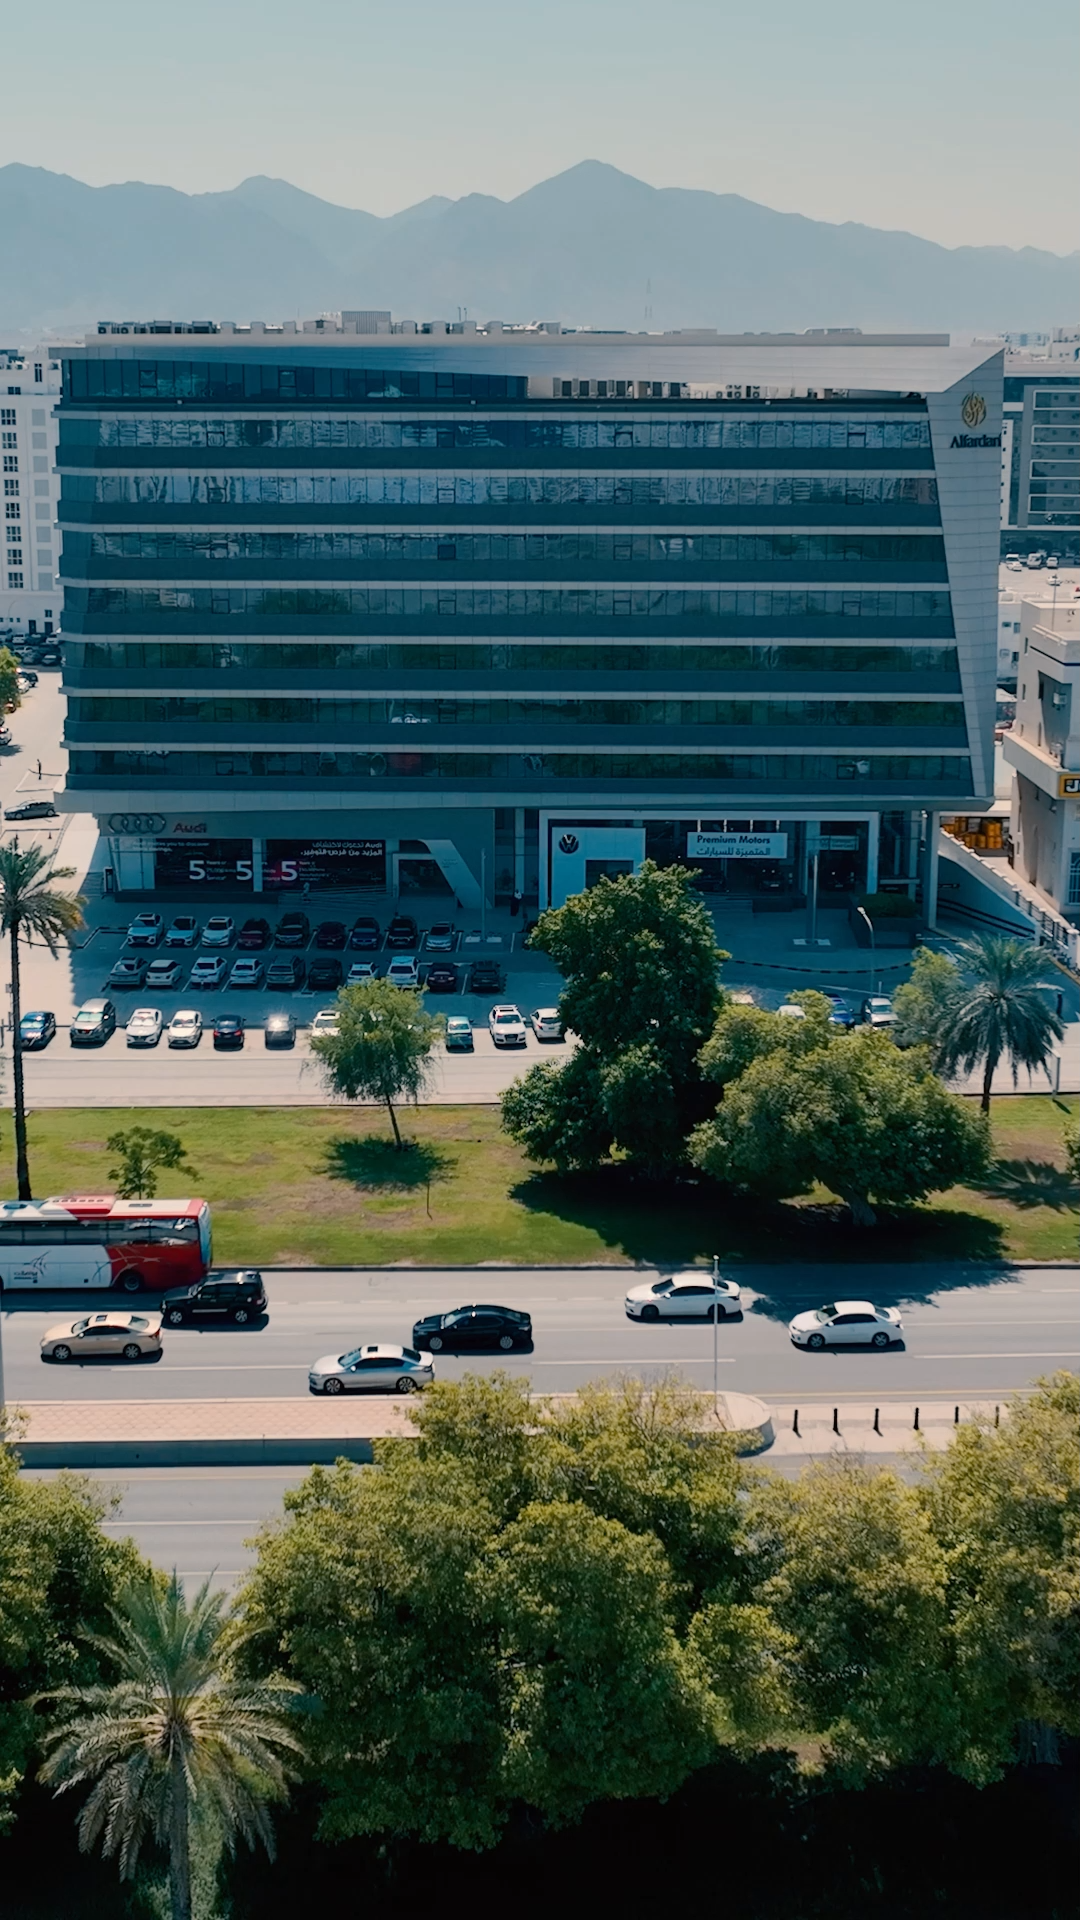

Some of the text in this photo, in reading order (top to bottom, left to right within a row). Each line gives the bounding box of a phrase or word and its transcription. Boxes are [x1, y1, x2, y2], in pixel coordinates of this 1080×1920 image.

[950, 433, 1001, 448] Alfardan
[173, 822, 207, 833] Audi
[697, 835, 770, 844] Premium Motors
[348, 848, 360, 856] من
[361, 849, 382, 857] المزيد
[696, 847, 771, 857] المتميزة للسيارات
[189, 860, 206, 881] 5
[236, 860, 252, 881] 5
[281, 860, 298, 881] 5
